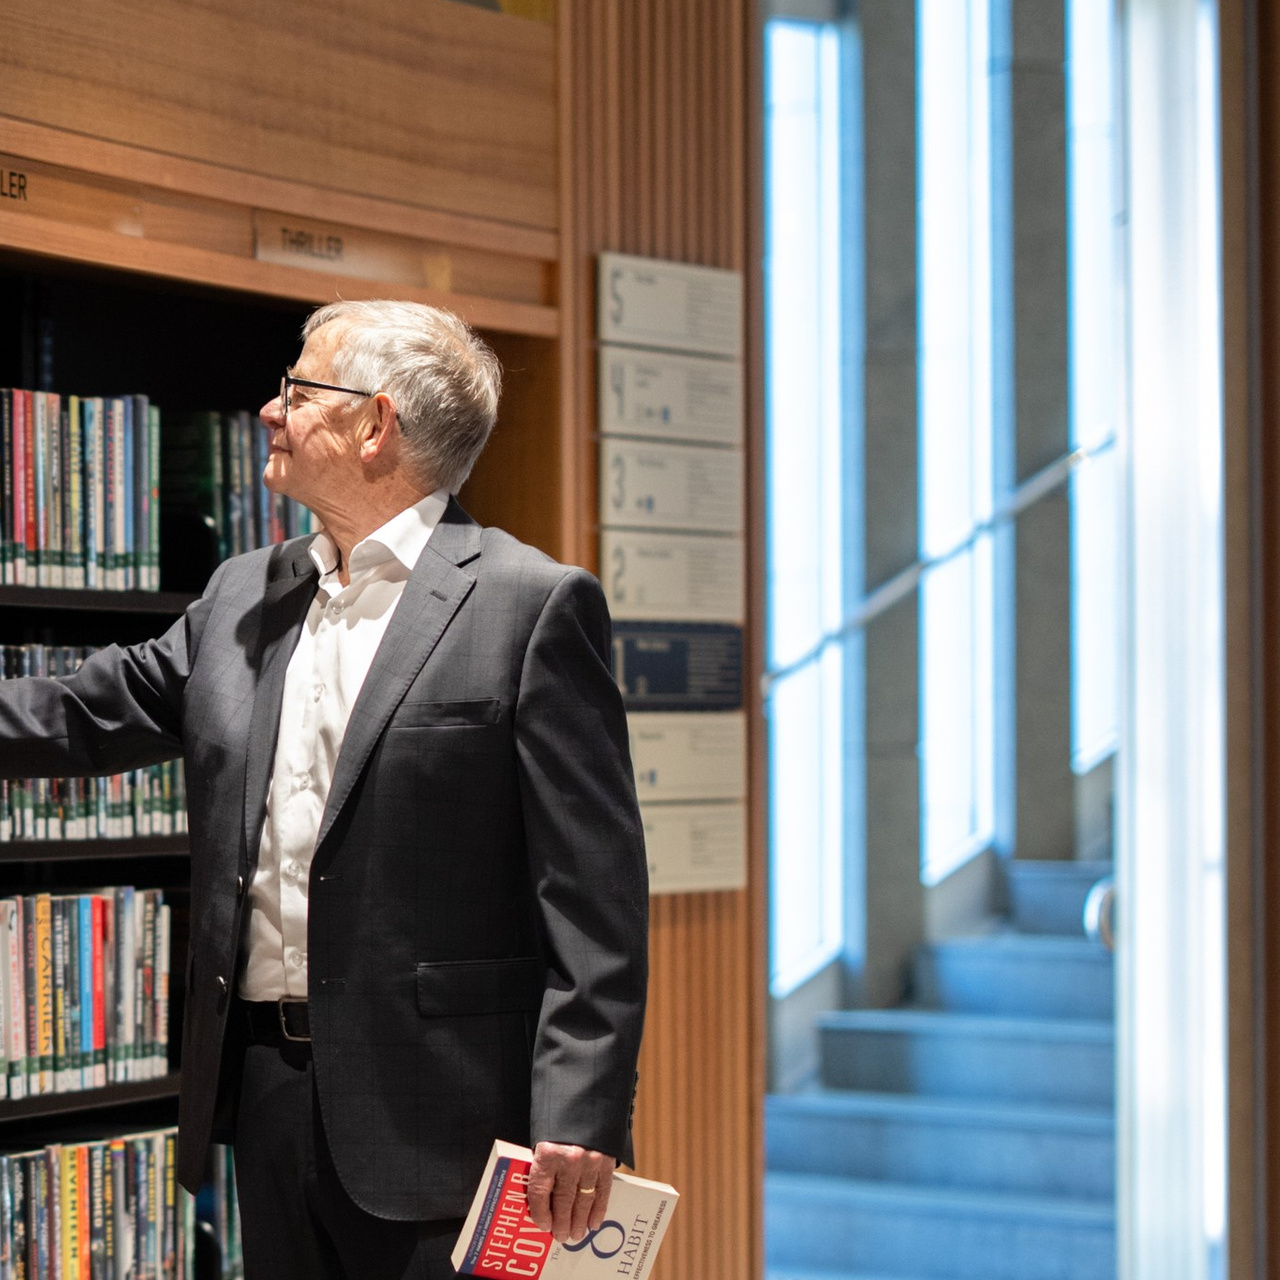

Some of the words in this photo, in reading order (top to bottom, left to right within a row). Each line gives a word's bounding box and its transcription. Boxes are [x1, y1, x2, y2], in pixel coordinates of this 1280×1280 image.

[280, 228, 345, 263] THRILLER
[93, 1150, 103, 1229] CONSUMED
[497, 1170, 506, 1188] PEOPLE
[68, 1149, 78, 1260] SEVENTEEN
[651, 1200, 668, 1231] GREATNESS
[481, 1189, 528, 1271] STEPHEN
[505, 1214, 551, 1277] COV
[562, 1219, 625, 1259] 8
[616, 1214, 649, 1276] HABIT
[648, 1230, 656, 1239] TO
[550, 1246, 562, 1262] The
[632, 1239, 653, 1280] EFFECTIVENESS
